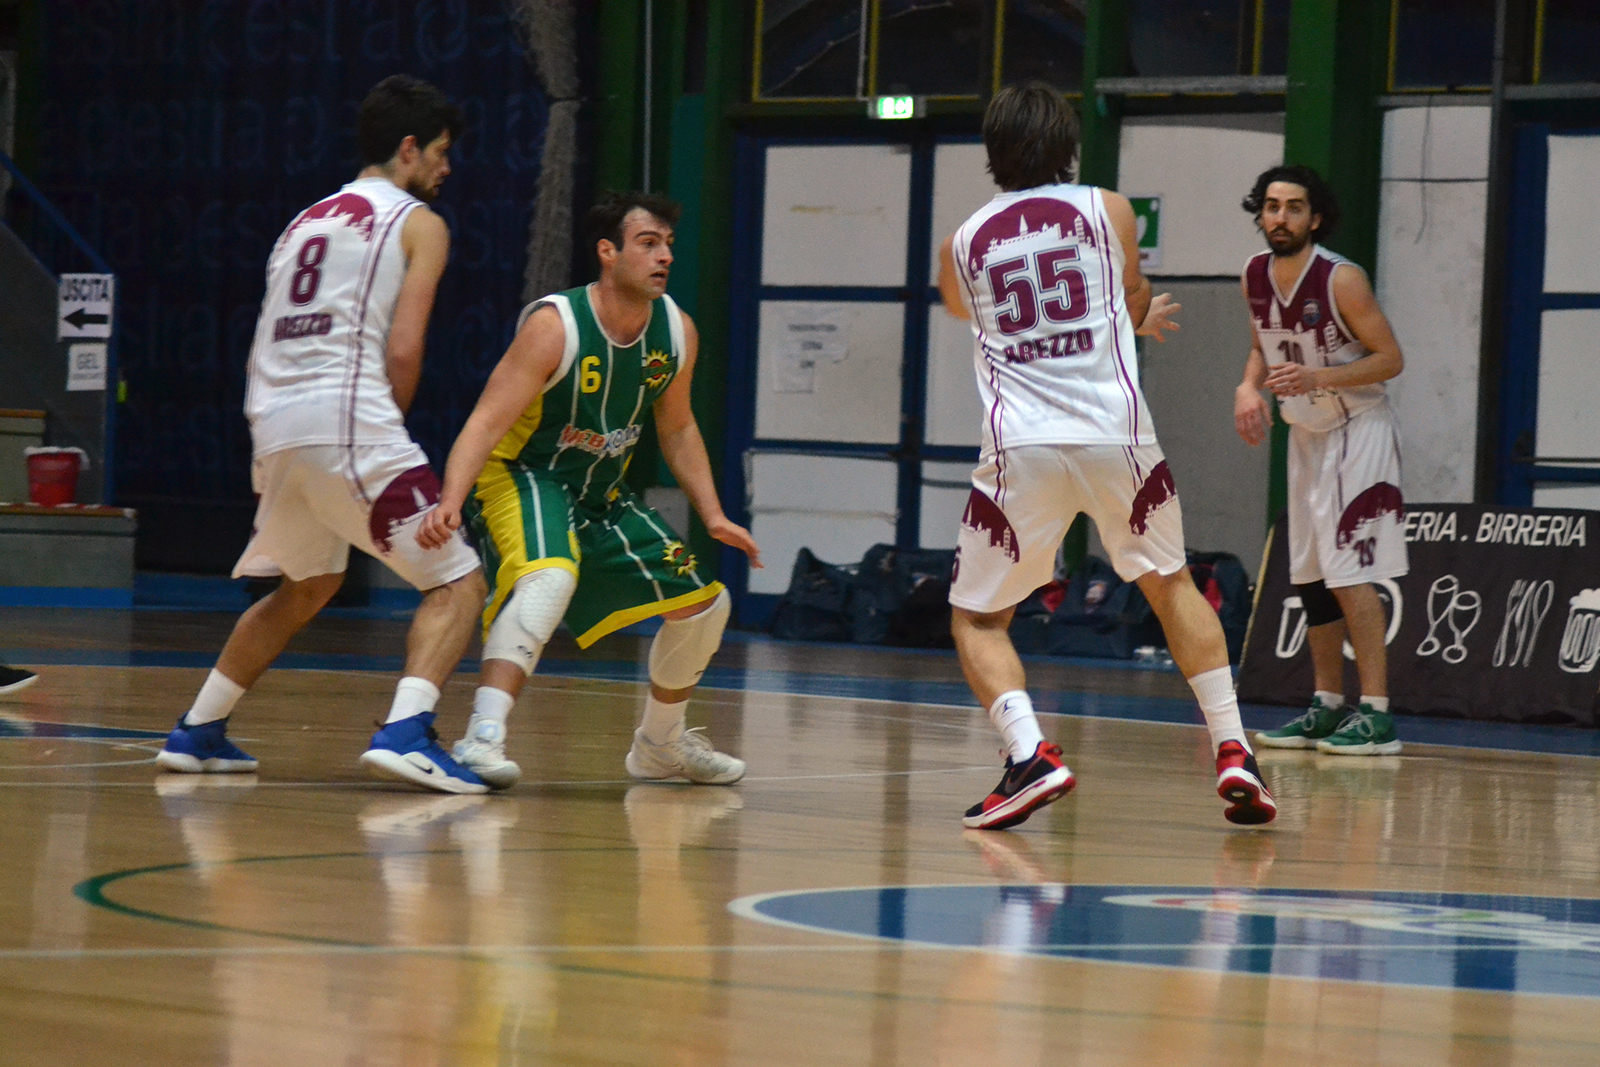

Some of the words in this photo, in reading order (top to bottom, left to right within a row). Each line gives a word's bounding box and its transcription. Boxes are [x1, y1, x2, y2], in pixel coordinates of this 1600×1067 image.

[289, 233, 329, 306] 8
[61, 277, 110, 301] USCITA
[985, 245, 1090, 336] 55
[1003, 328, 1095, 363] AREZZO
[580, 355, 602, 393] 6
[1475, 512, 1586, 547] BIRRERIA
